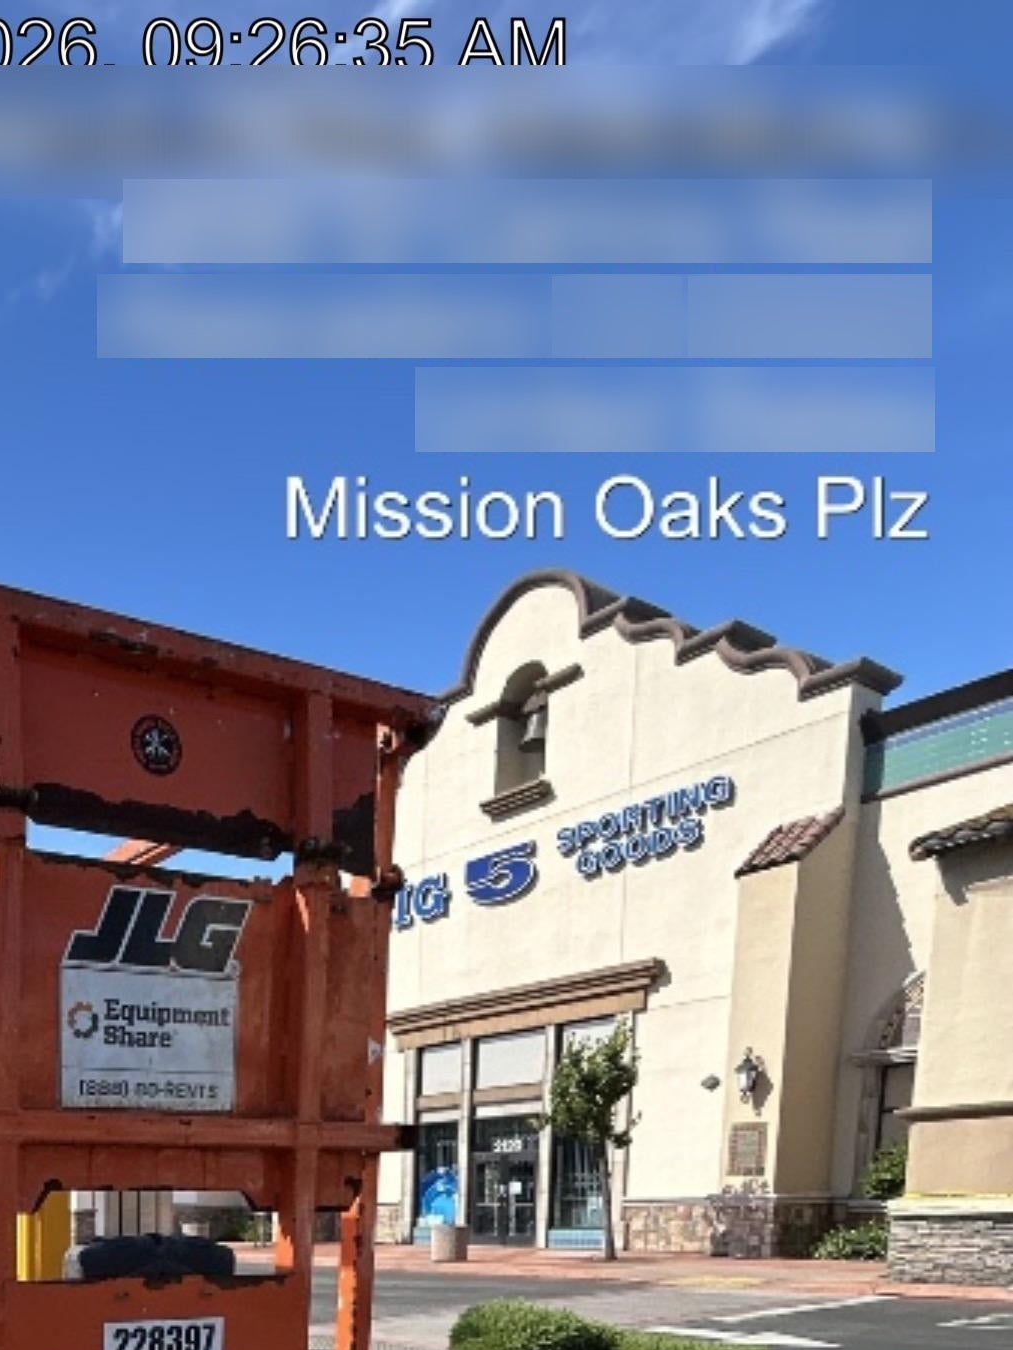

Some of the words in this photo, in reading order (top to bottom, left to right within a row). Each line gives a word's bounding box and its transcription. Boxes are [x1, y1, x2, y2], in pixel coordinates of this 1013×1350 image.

[557, 776, 736, 855] SPORTING
[576, 818, 704, 881] GOODS
[394, 873, 451, 932] IG
[465, 839, 539, 905] 5
[61, 884, 252, 975] JLG
[103, 998, 231, 1027] Equipment
[103, 1025, 172, 1048] Share
